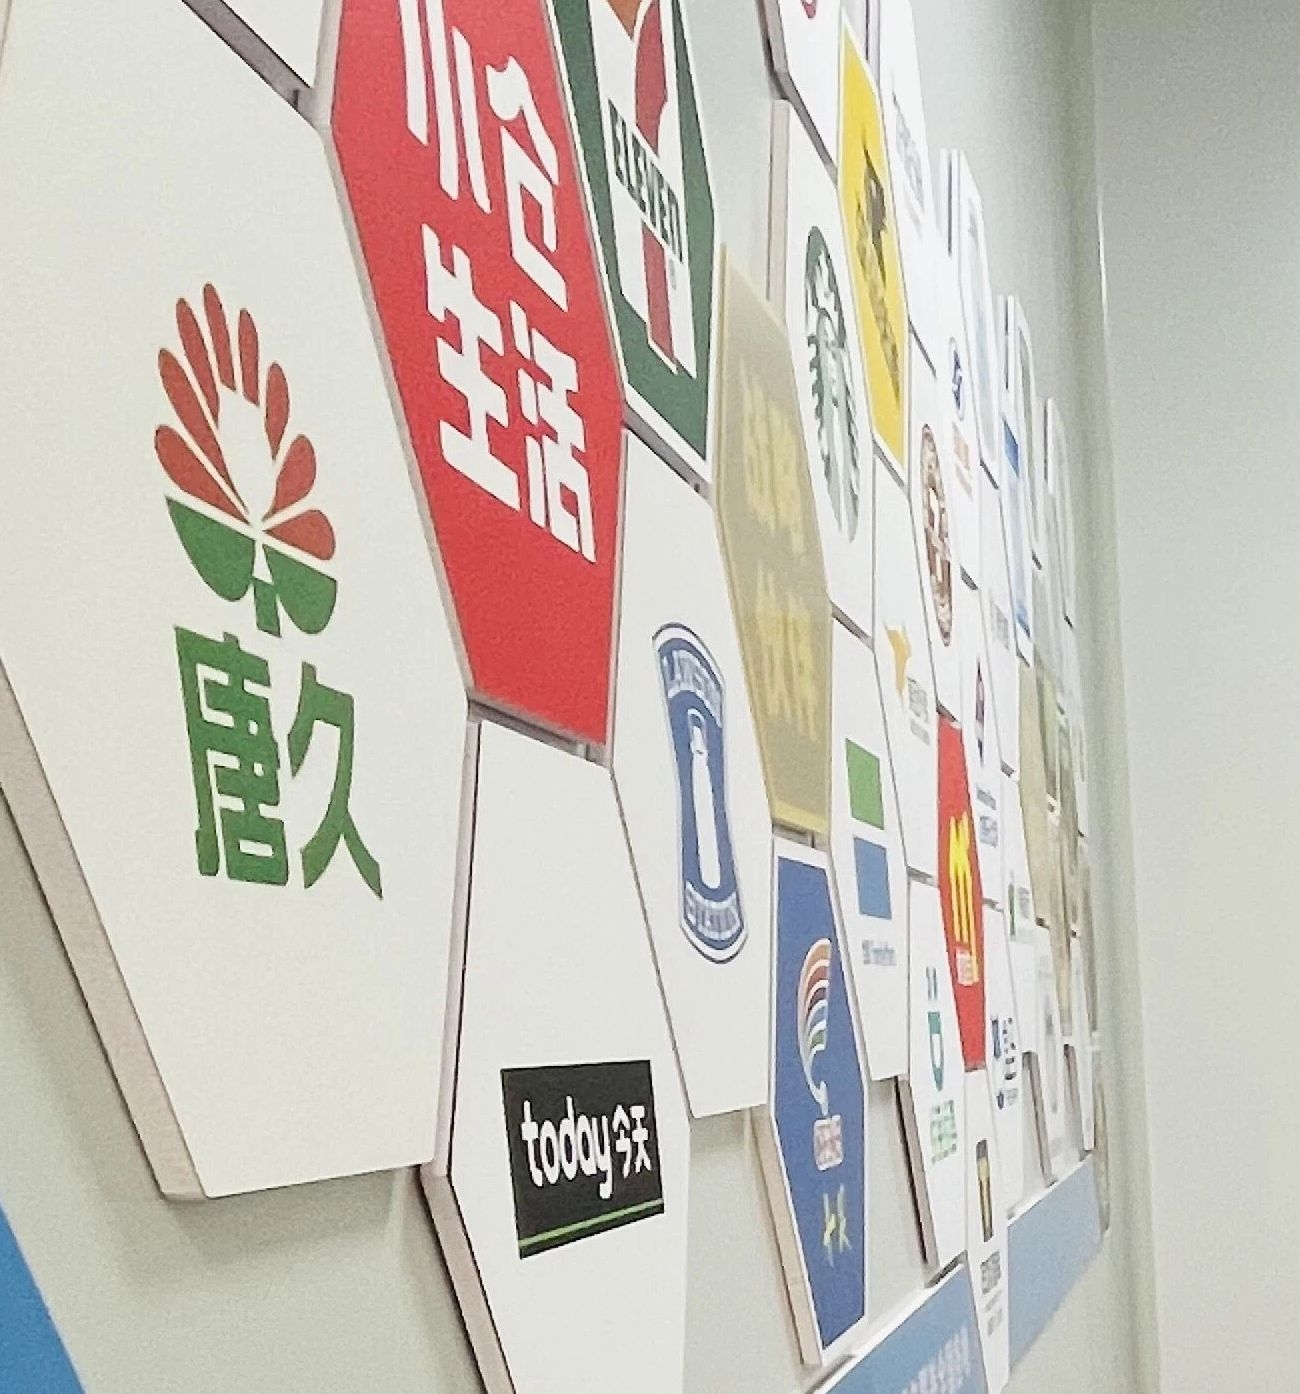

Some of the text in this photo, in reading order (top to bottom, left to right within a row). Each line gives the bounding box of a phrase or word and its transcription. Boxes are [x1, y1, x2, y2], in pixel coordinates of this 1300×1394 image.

[421, 222, 597, 564] 生活
[173, 623, 384, 900] 唐久
[521, 1095, 652, 1199] today 今天
